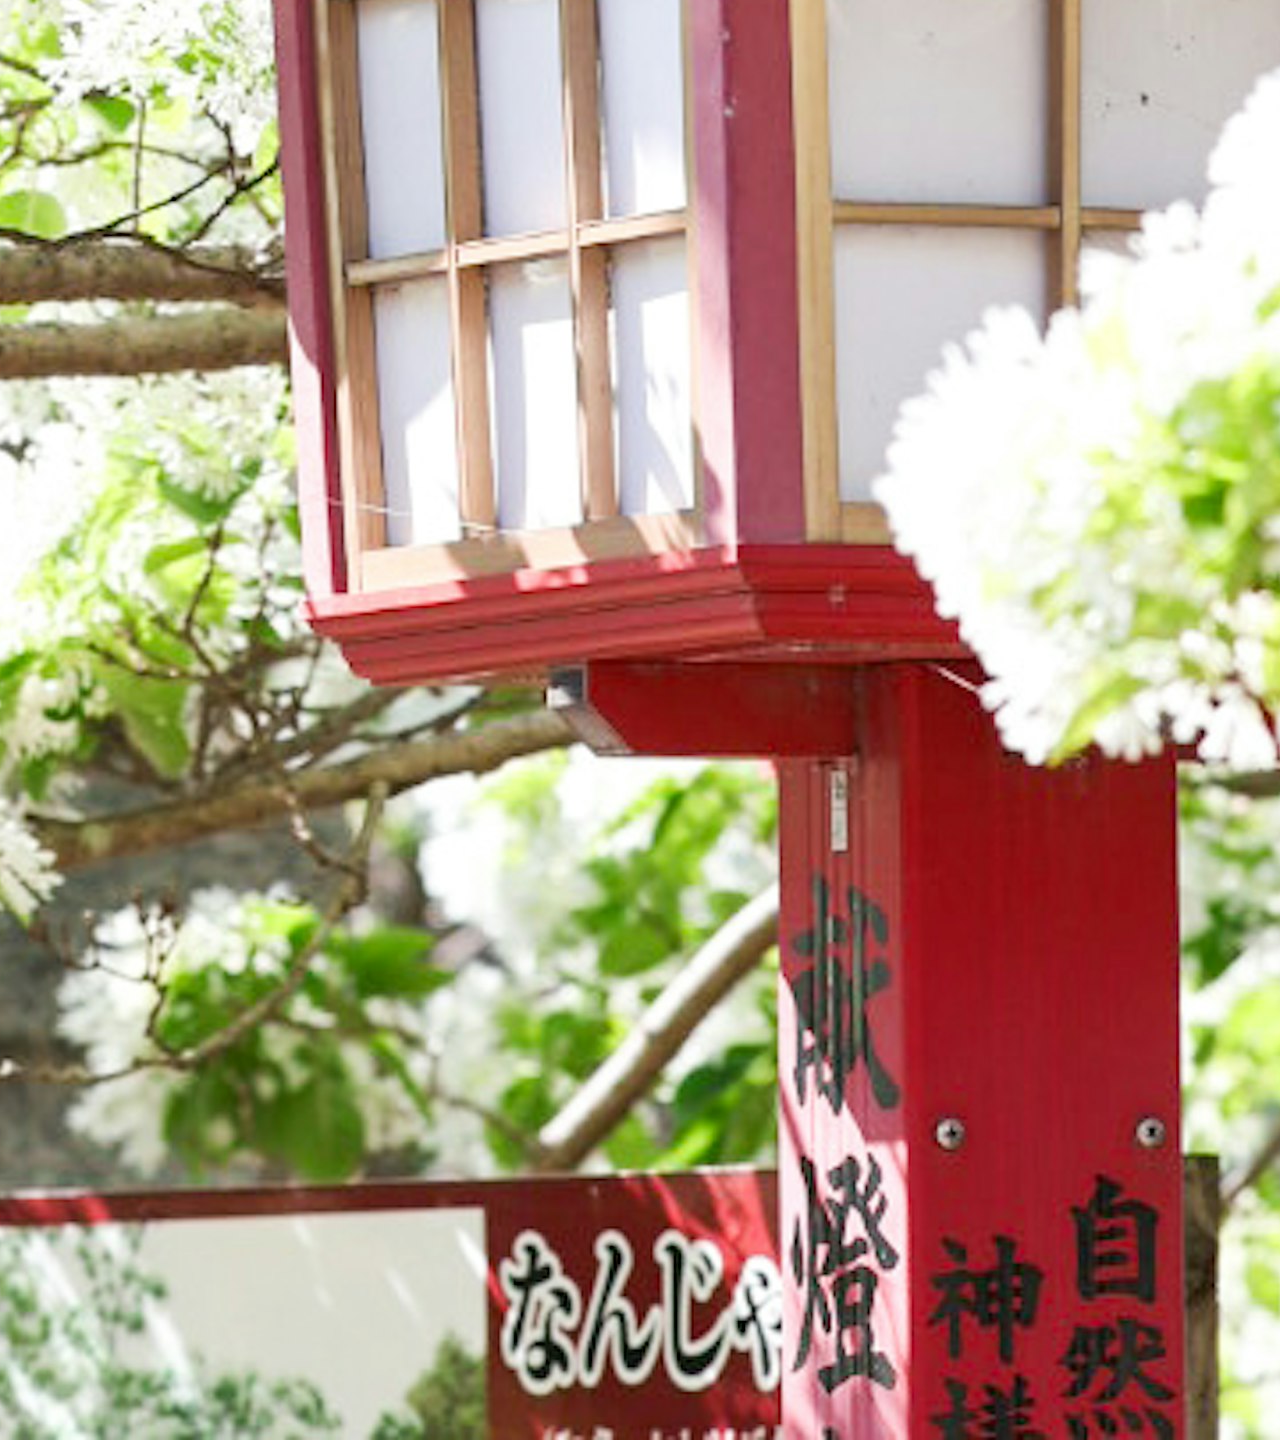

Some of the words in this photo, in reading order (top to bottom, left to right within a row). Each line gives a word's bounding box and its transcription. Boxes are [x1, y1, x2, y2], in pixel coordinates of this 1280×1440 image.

[500, 1229, 782, 1396] なんじゃ
[1060, 1174, 1176, 1440] 自然
